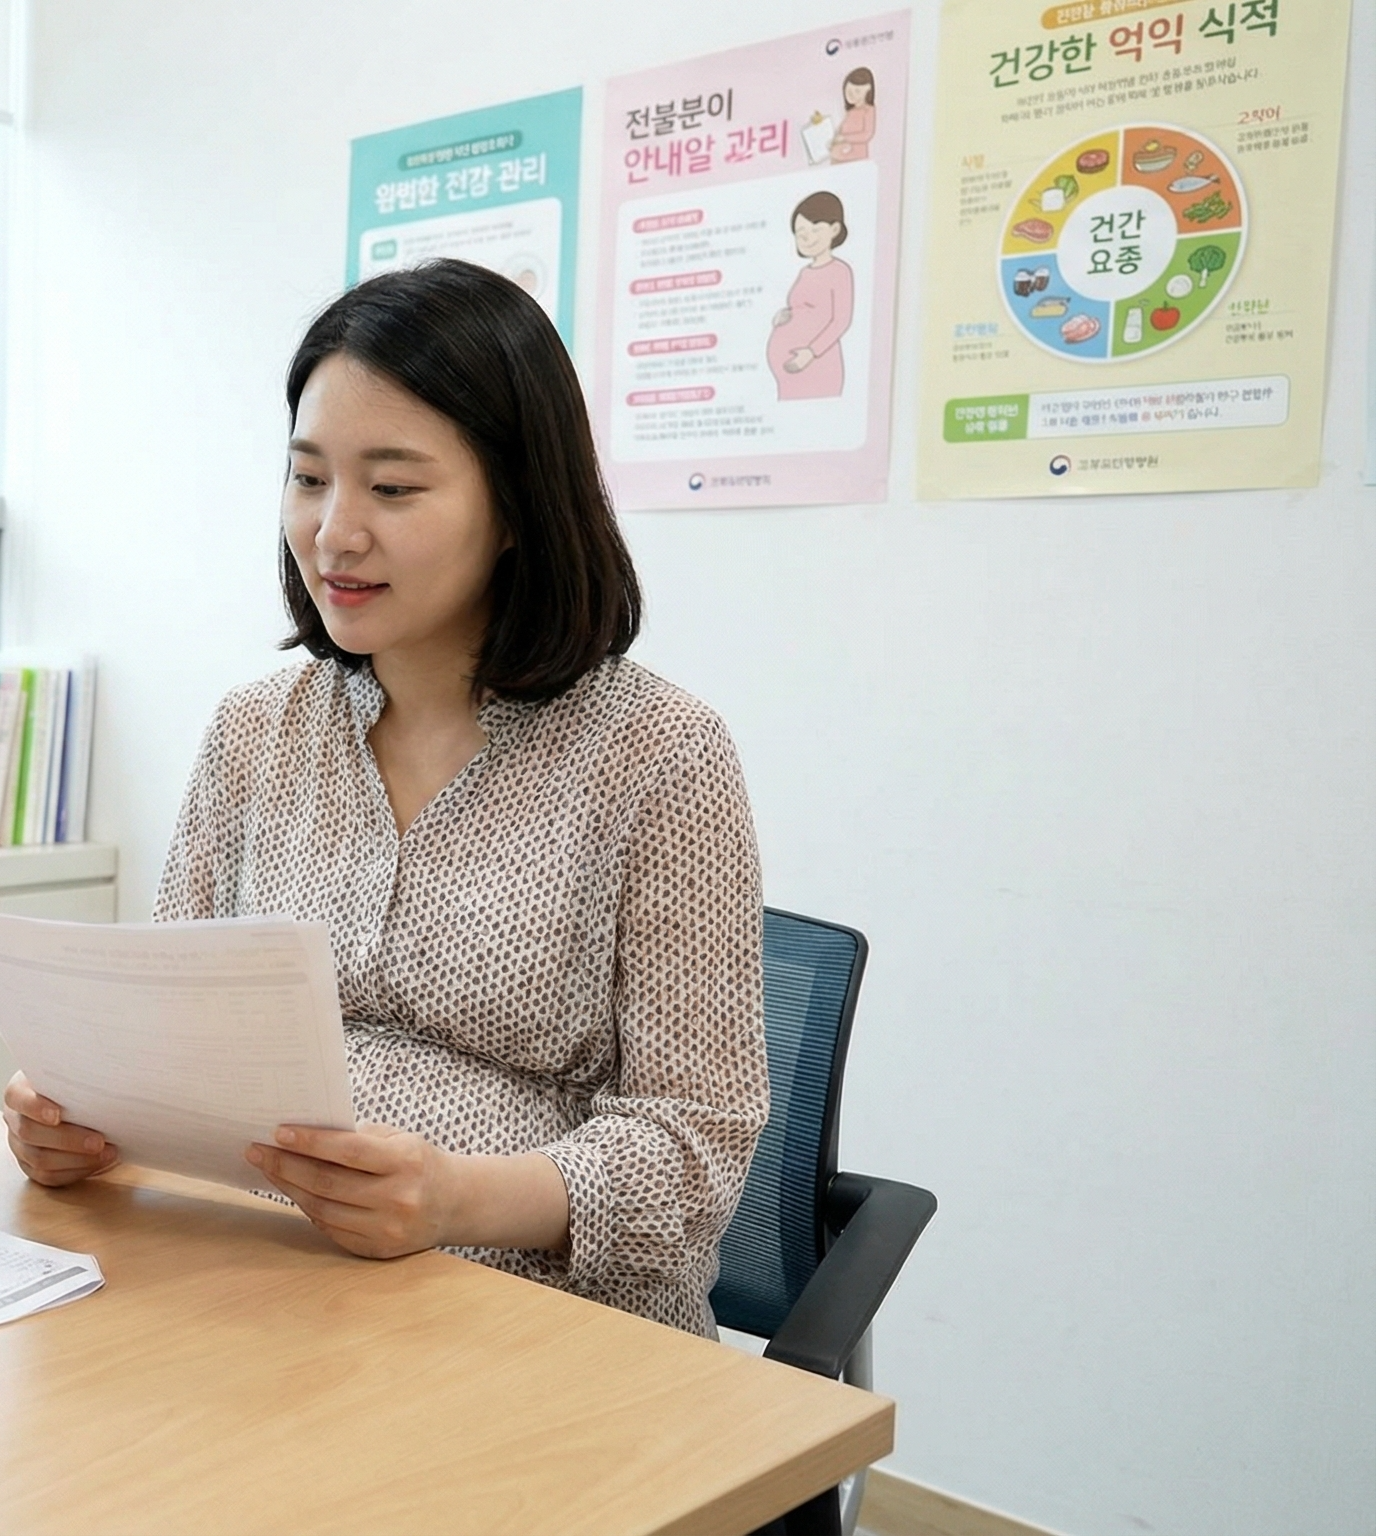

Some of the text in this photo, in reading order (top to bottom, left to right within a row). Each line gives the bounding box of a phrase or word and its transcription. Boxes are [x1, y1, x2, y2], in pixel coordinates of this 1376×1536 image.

[989, 32, 1097, 88] 건강한
[1109, 14, 1184, 62] 억익
[1199, 0, 1278, 44] 식적
[495, 151, 547, 193] 관리
[624, 134, 716, 184] 안내알
[1090, 209, 1147, 243] 건간
[1087, 245, 1143, 275] 요종
